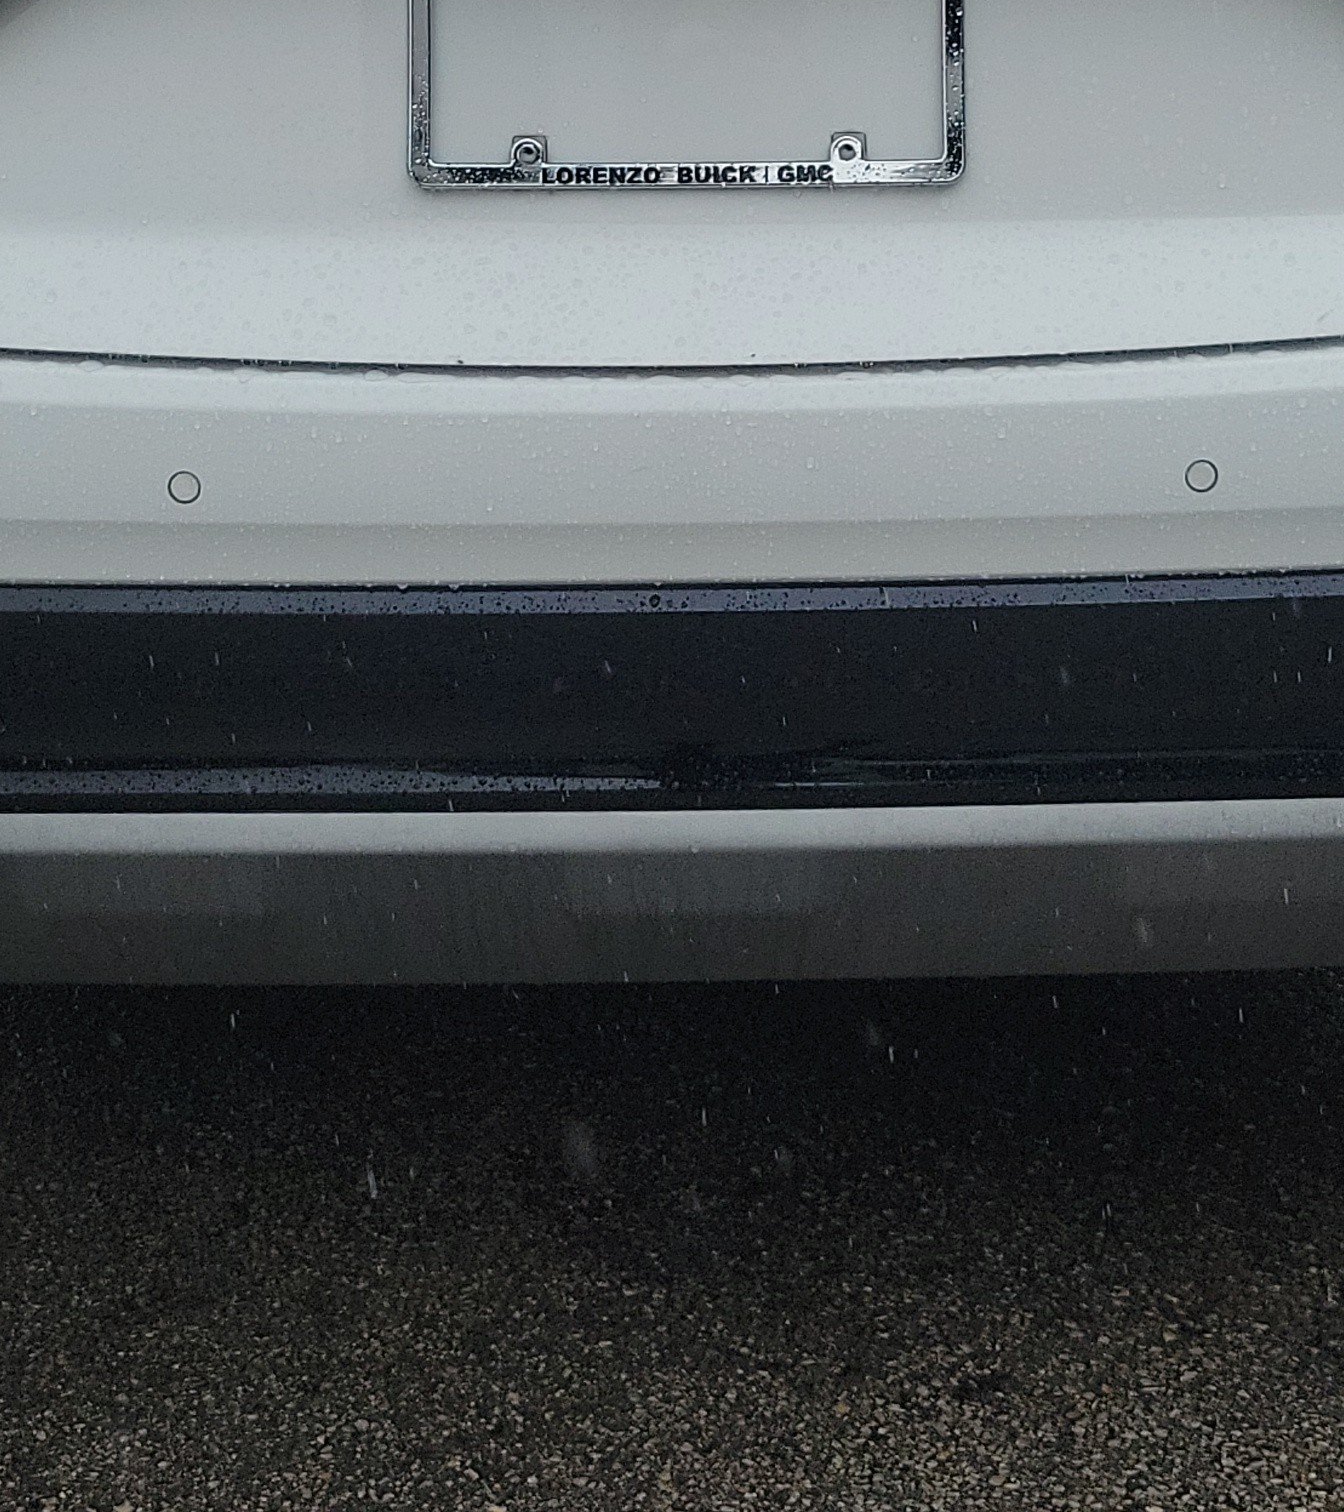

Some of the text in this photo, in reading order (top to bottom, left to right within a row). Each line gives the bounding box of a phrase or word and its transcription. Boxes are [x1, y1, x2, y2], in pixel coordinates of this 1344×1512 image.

[542, 166, 659, 184] LORENZO
[677, 165, 756, 183] BUICK
[777, 165, 834, 182] GMC
